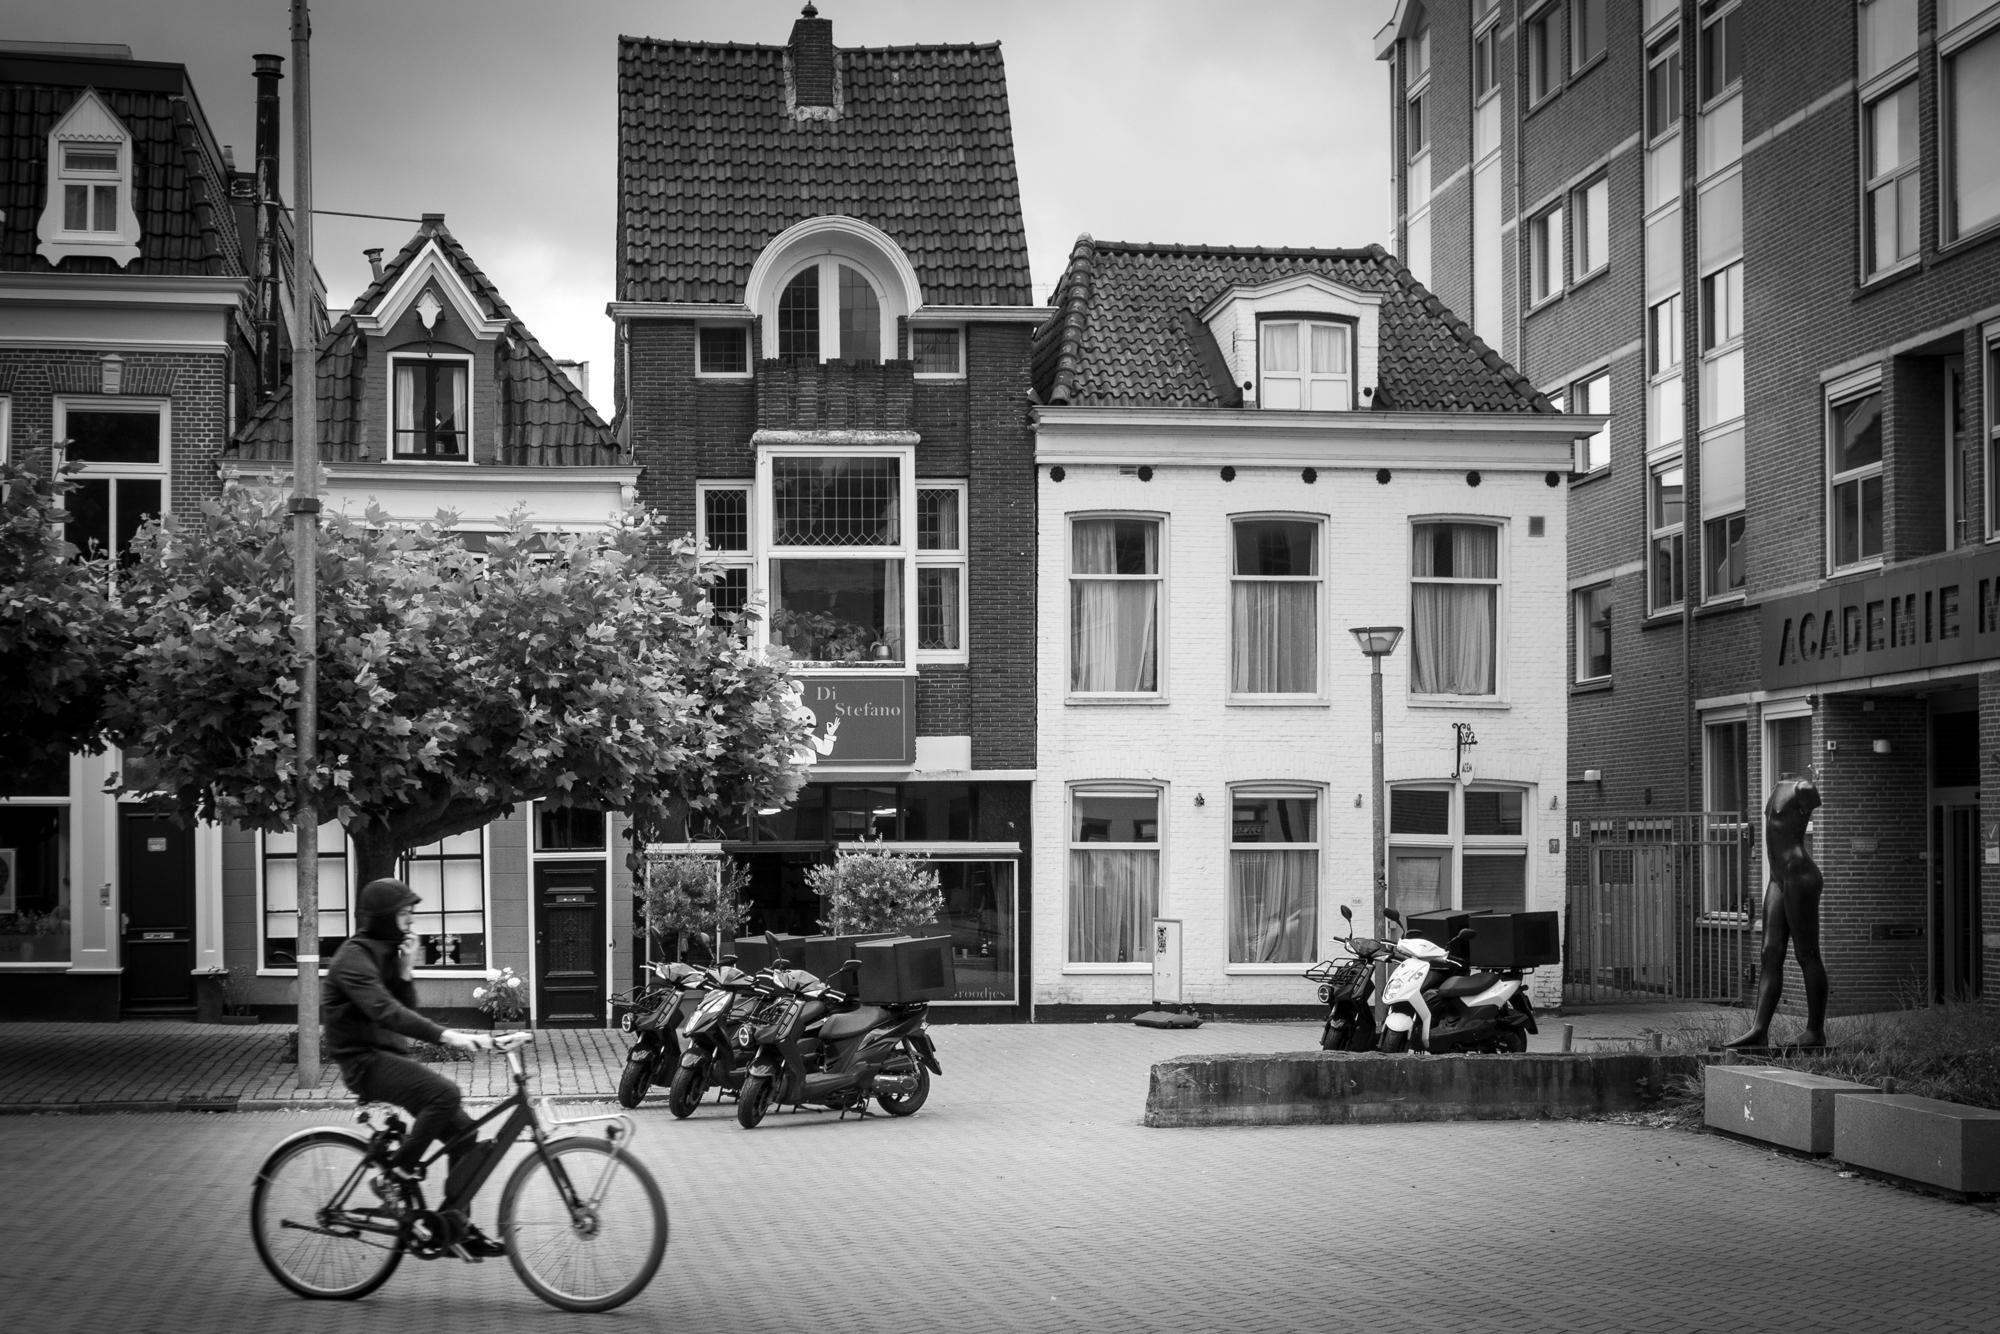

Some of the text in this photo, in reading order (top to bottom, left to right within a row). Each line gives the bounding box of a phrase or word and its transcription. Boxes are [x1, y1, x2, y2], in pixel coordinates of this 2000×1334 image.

[1779, 585, 1960, 666] ACADEMIE
[817, 685, 836, 701] Di
[835, 702, 901, 717] Stefano
[953, 986, 1006, 1001] roodjes
